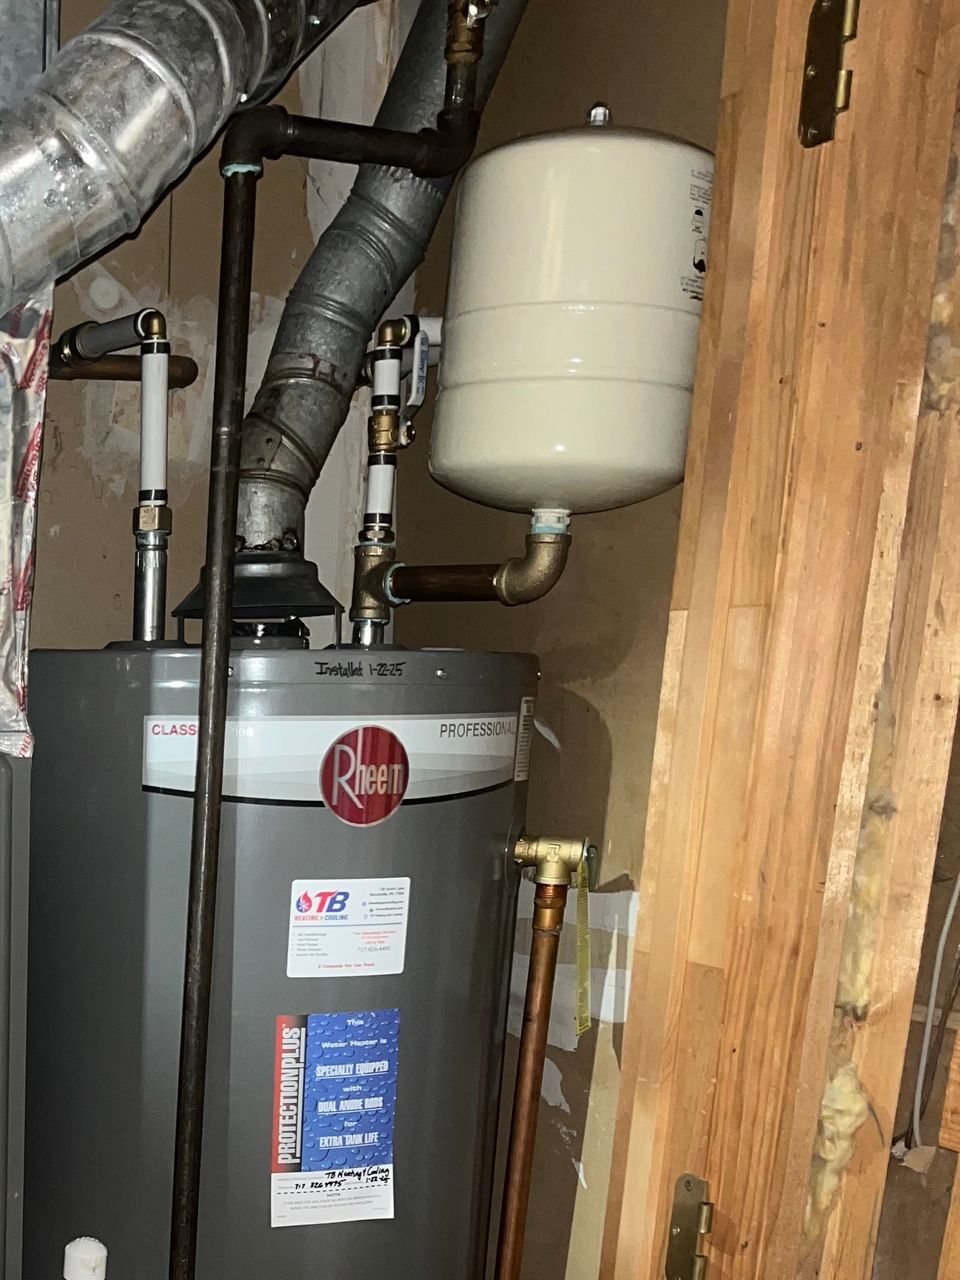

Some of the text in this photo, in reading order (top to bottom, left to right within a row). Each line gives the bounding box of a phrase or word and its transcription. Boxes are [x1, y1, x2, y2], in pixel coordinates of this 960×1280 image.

[369, 662, 406, 676] 1-22-25
[152, 722, 515, 738] CLASS PROFESSIONAL
[332, 727, 403, 809] Rheem
[314, 890, 350, 912] TB
[316, 1060, 389, 1077] SPECIALLY EQUIPPED
[278, 1027, 303, 1165] PROTECTIONPLUS
[343, 1084, 362, 1092] with
[318, 1096, 383, 1113] DUAL ANODE RODS
[320, 1131, 379, 1148] EXTRA TANK LIFE
